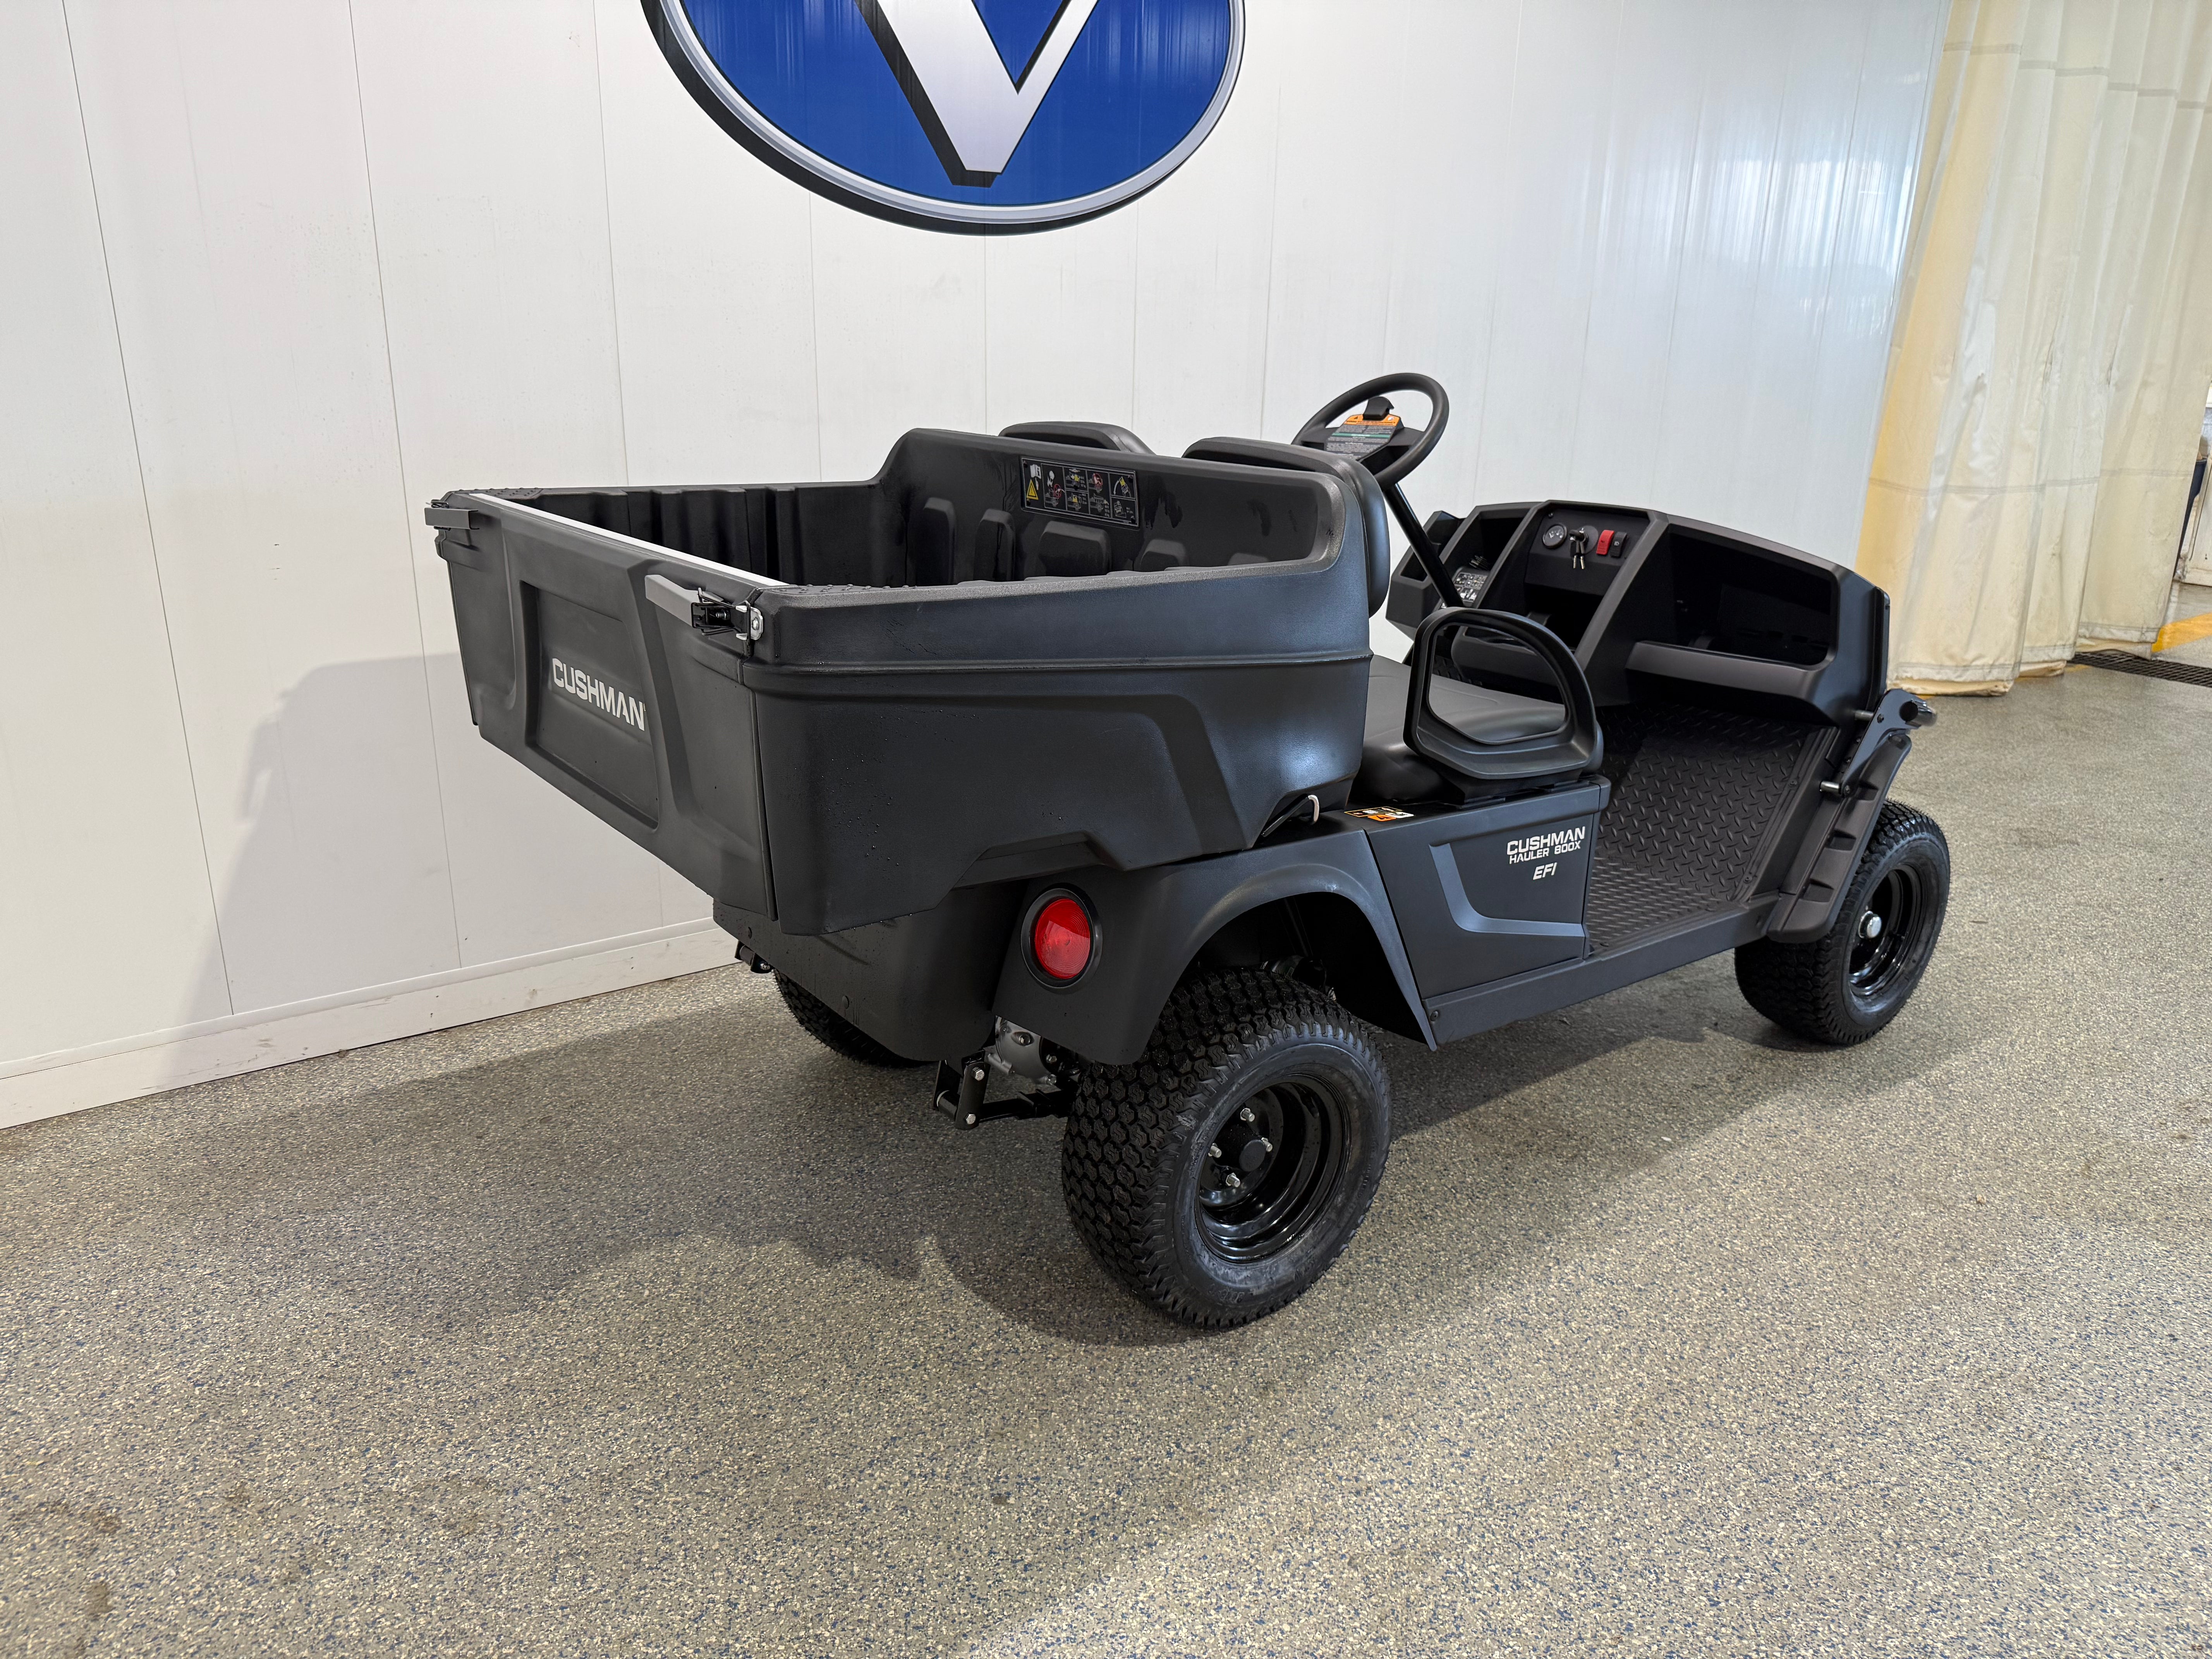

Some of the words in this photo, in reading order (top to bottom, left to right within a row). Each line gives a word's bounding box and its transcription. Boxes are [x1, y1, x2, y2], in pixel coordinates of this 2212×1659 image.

[552, 658, 645, 731] CUSHMAN
[1506, 826, 1585, 855] CUSHMAN
[1509, 848, 1549, 864] HAULER
[1554, 840, 1581, 855] 800X
[1532, 862, 1558, 880] EFI
